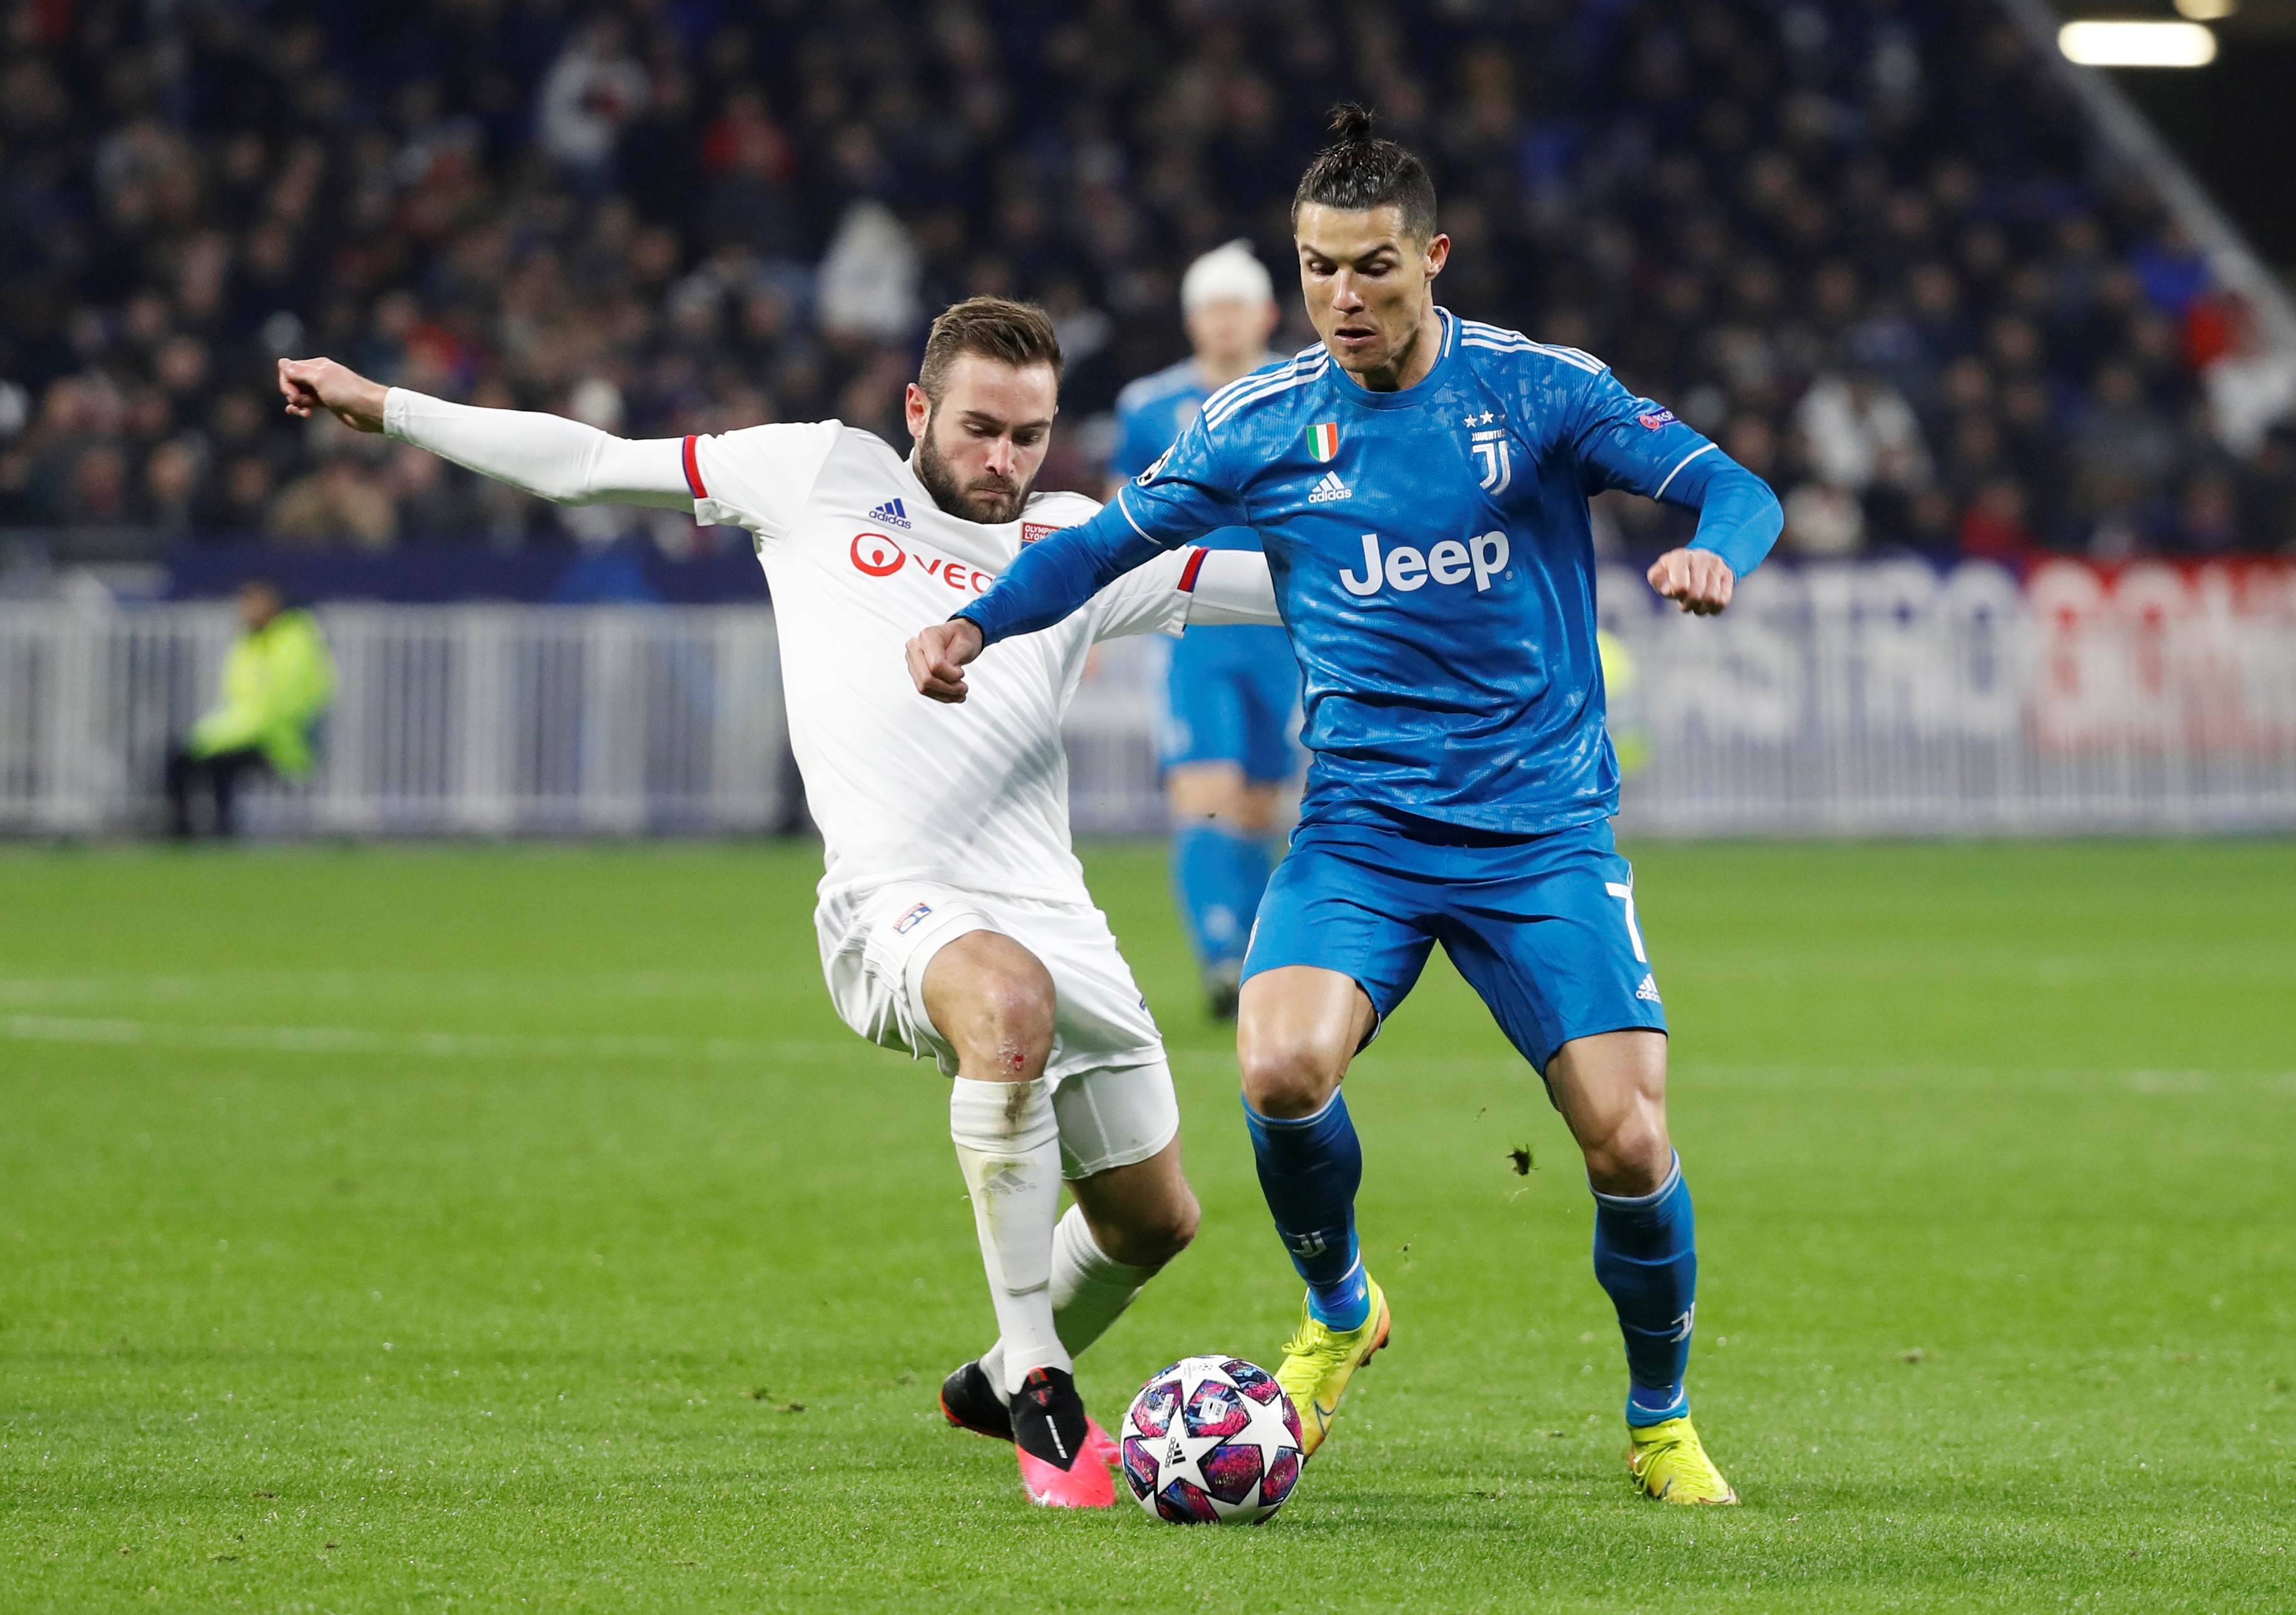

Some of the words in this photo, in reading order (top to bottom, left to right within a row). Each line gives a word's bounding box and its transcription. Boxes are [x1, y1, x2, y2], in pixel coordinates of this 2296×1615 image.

[1308, 488, 1352, 503] adidas
[868, 510, 912, 530] adidas
[1025, 525, 1058, 534] OLYMPI
[913, 554, 993, 594] VEO
[1339, 530, 1510, 596] Jeep
[1605, 882, 1647, 963] 7
[1165, 1437, 1176, 1468] adidas
